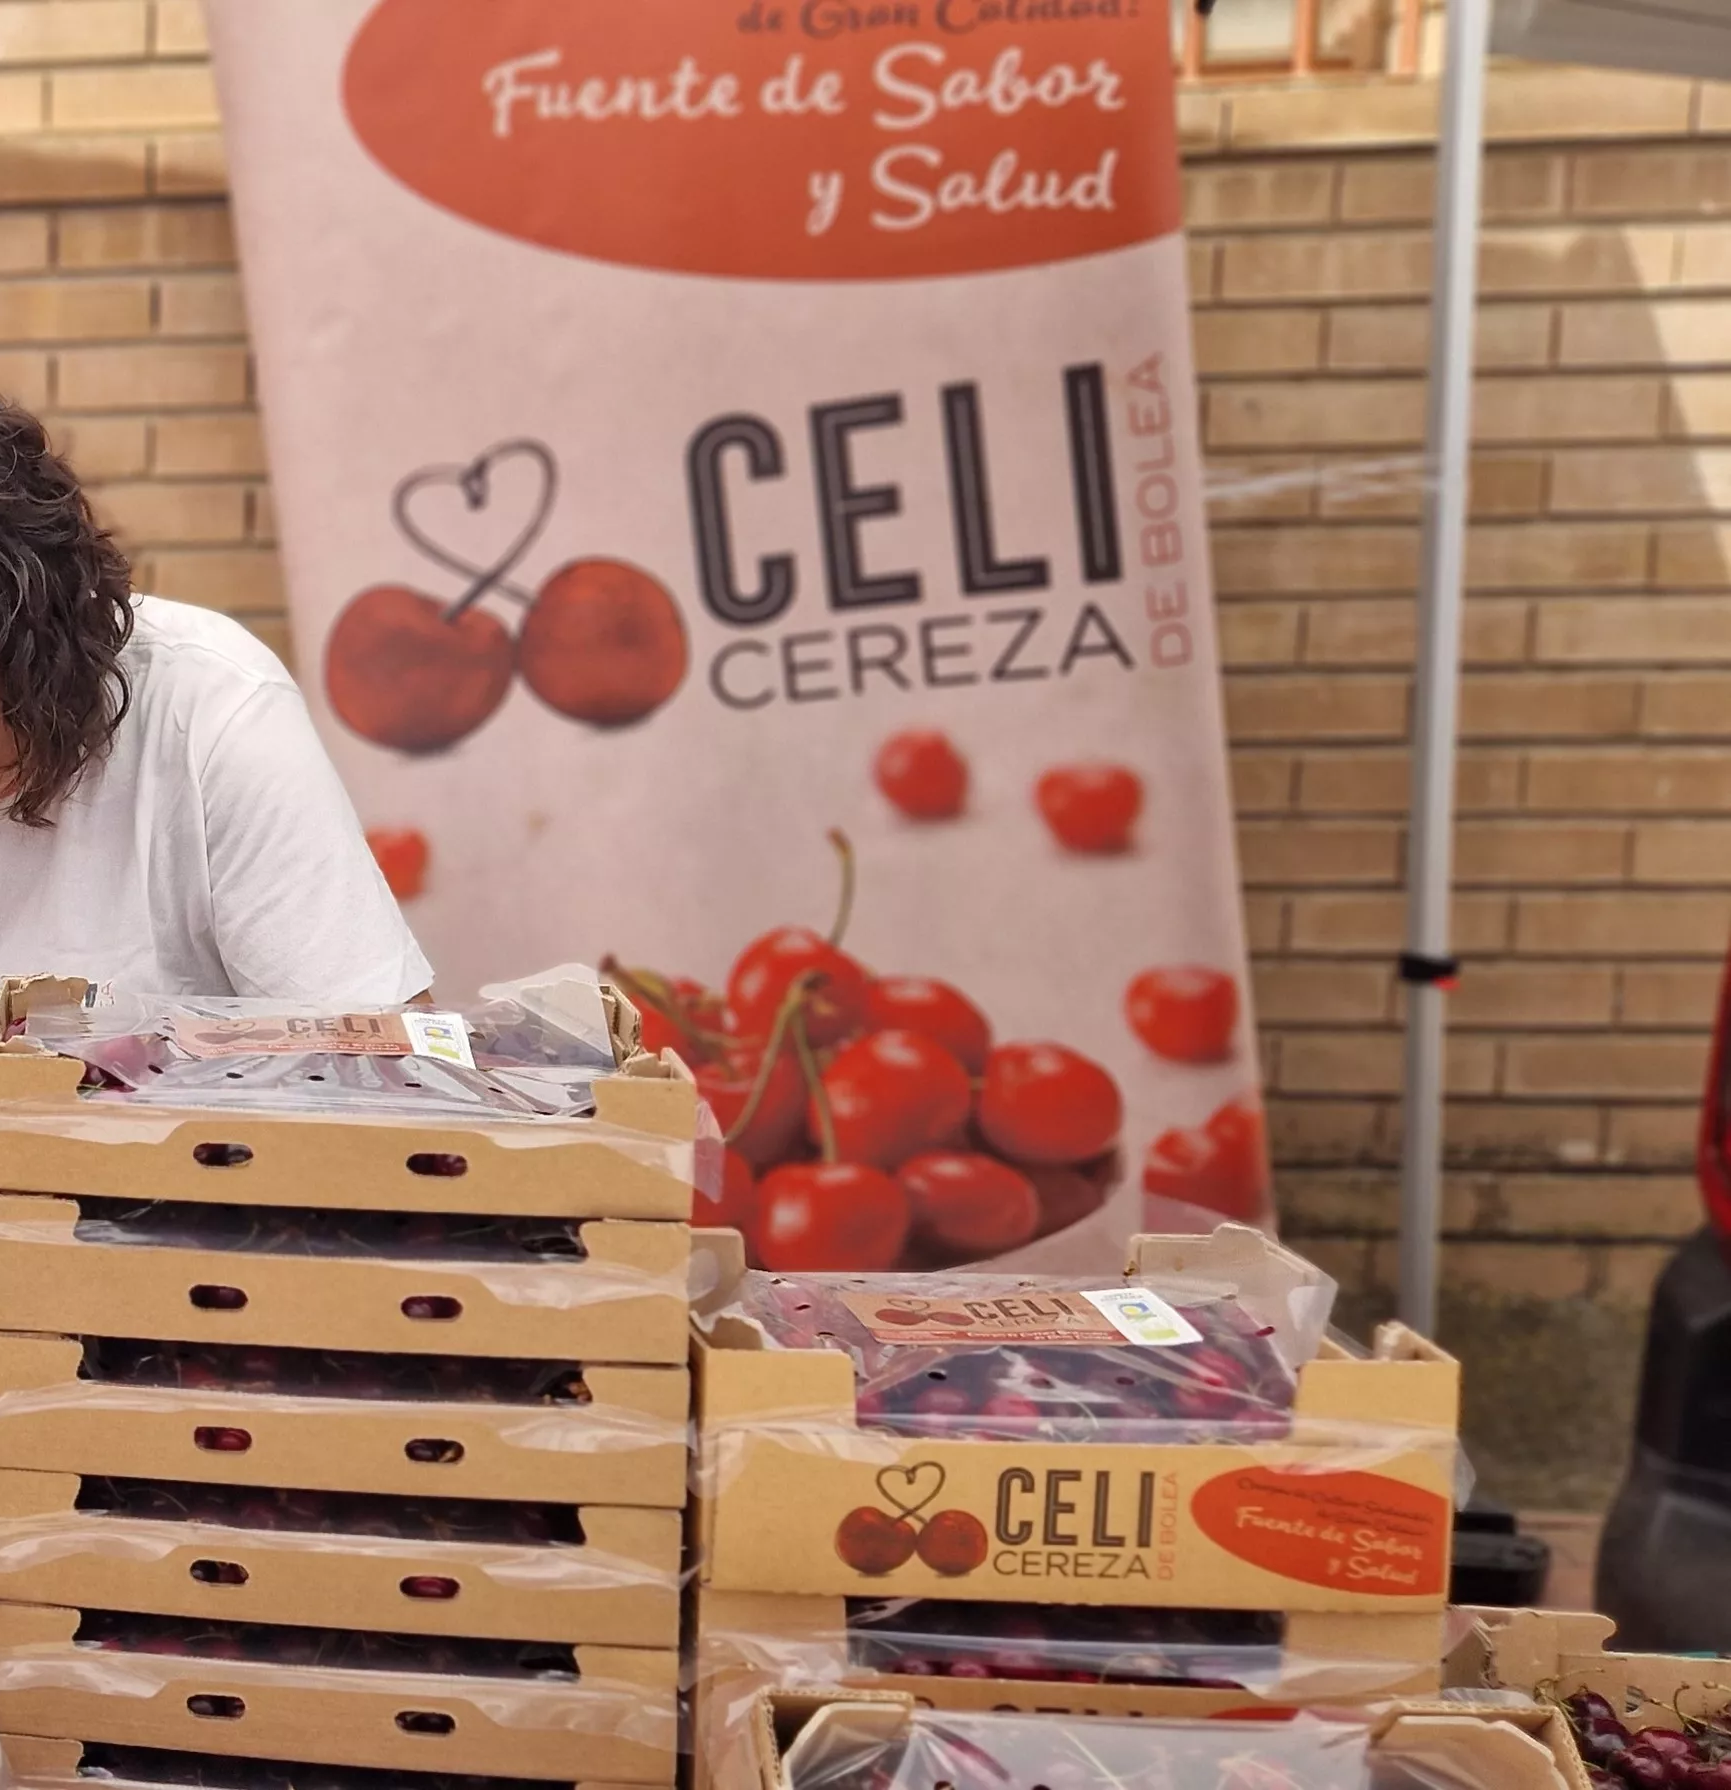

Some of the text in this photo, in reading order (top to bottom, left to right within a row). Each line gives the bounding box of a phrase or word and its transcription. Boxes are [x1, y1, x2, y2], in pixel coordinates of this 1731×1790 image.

[483, 42, 1125, 137] Fuente de Sabor
[806, 145, 1117, 234] y Salud
[684, 362, 1123, 629] CELI
[1125, 351, 1193, 668] DE BOLEA
[708, 604, 1136, 710] CEREZA
[286, 1017, 382, 1034] CELI
[964, 1297, 1076, 1320] CELI
[995, 1467, 1155, 1548] CELI
[1157, 1471, 1178, 1582] DE BOLEA
[1235, 1506, 1314, 1538] Fuente
[1351, 1529, 1422, 1561] Sabor
[993, 1550, 1151, 1580] CEREZA
[1345, 1556, 1419, 1585] Salud
